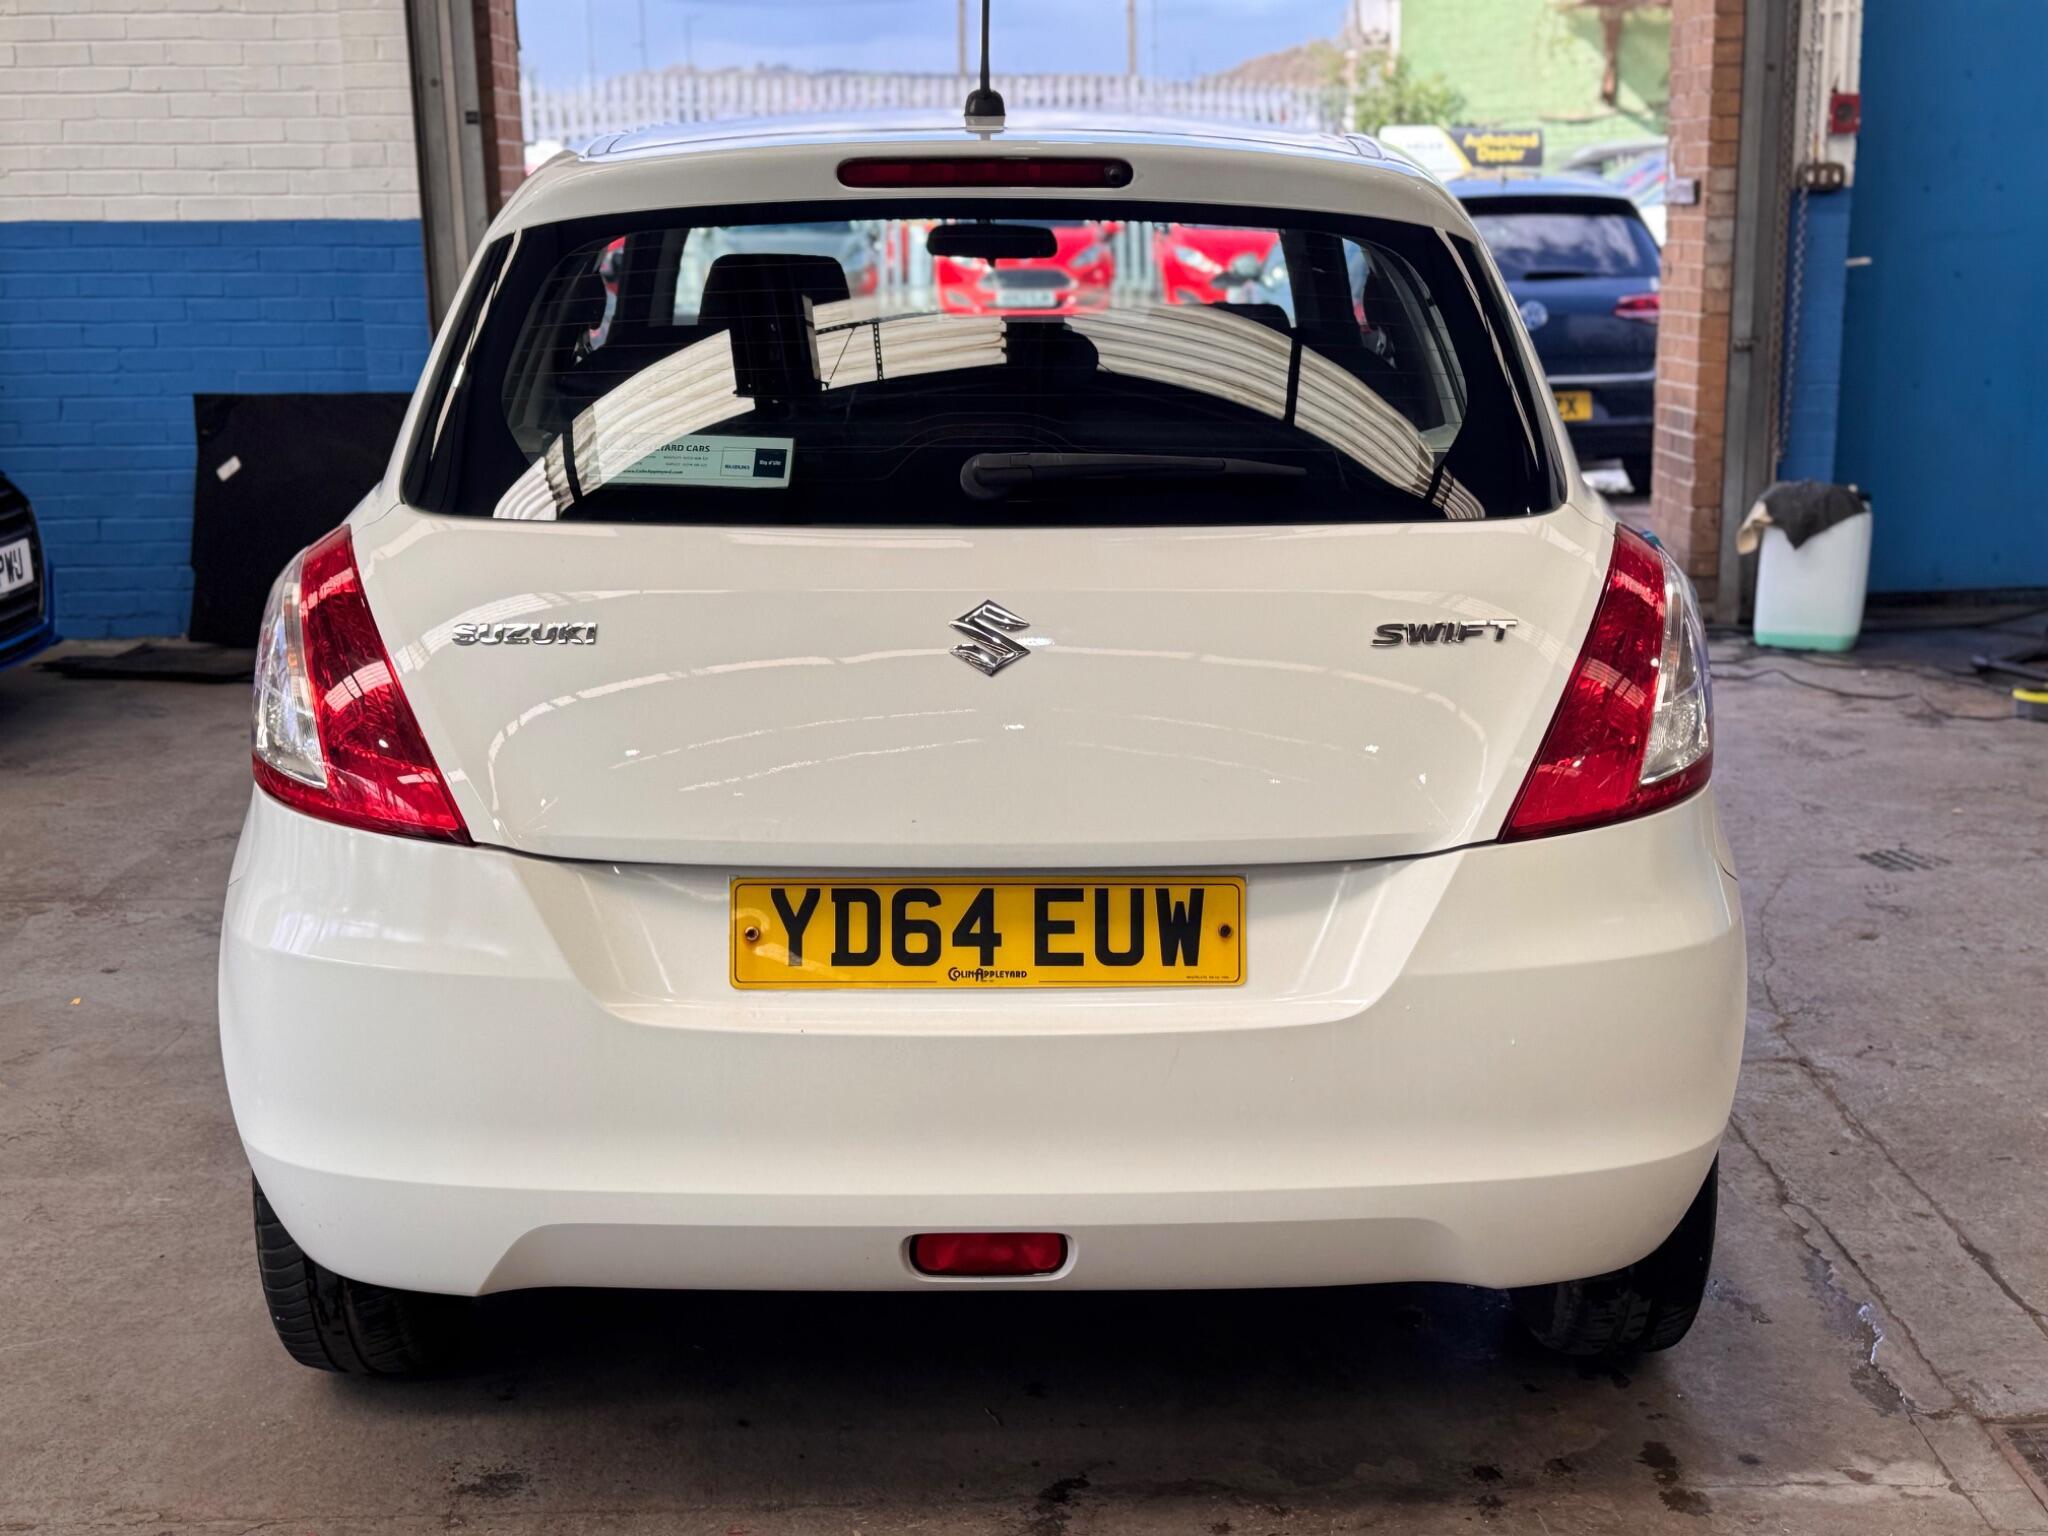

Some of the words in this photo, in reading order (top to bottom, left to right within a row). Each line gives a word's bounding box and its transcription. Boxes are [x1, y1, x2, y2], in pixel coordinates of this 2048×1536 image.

[686, 444, 711, 453] CARS
[452, 622, 598, 646] SUZUKI
[1371, 619, 1518, 648] SWIFT
[770, 888, 1003, 966] YD64
[1034, 888, 1205, 966] EUW
